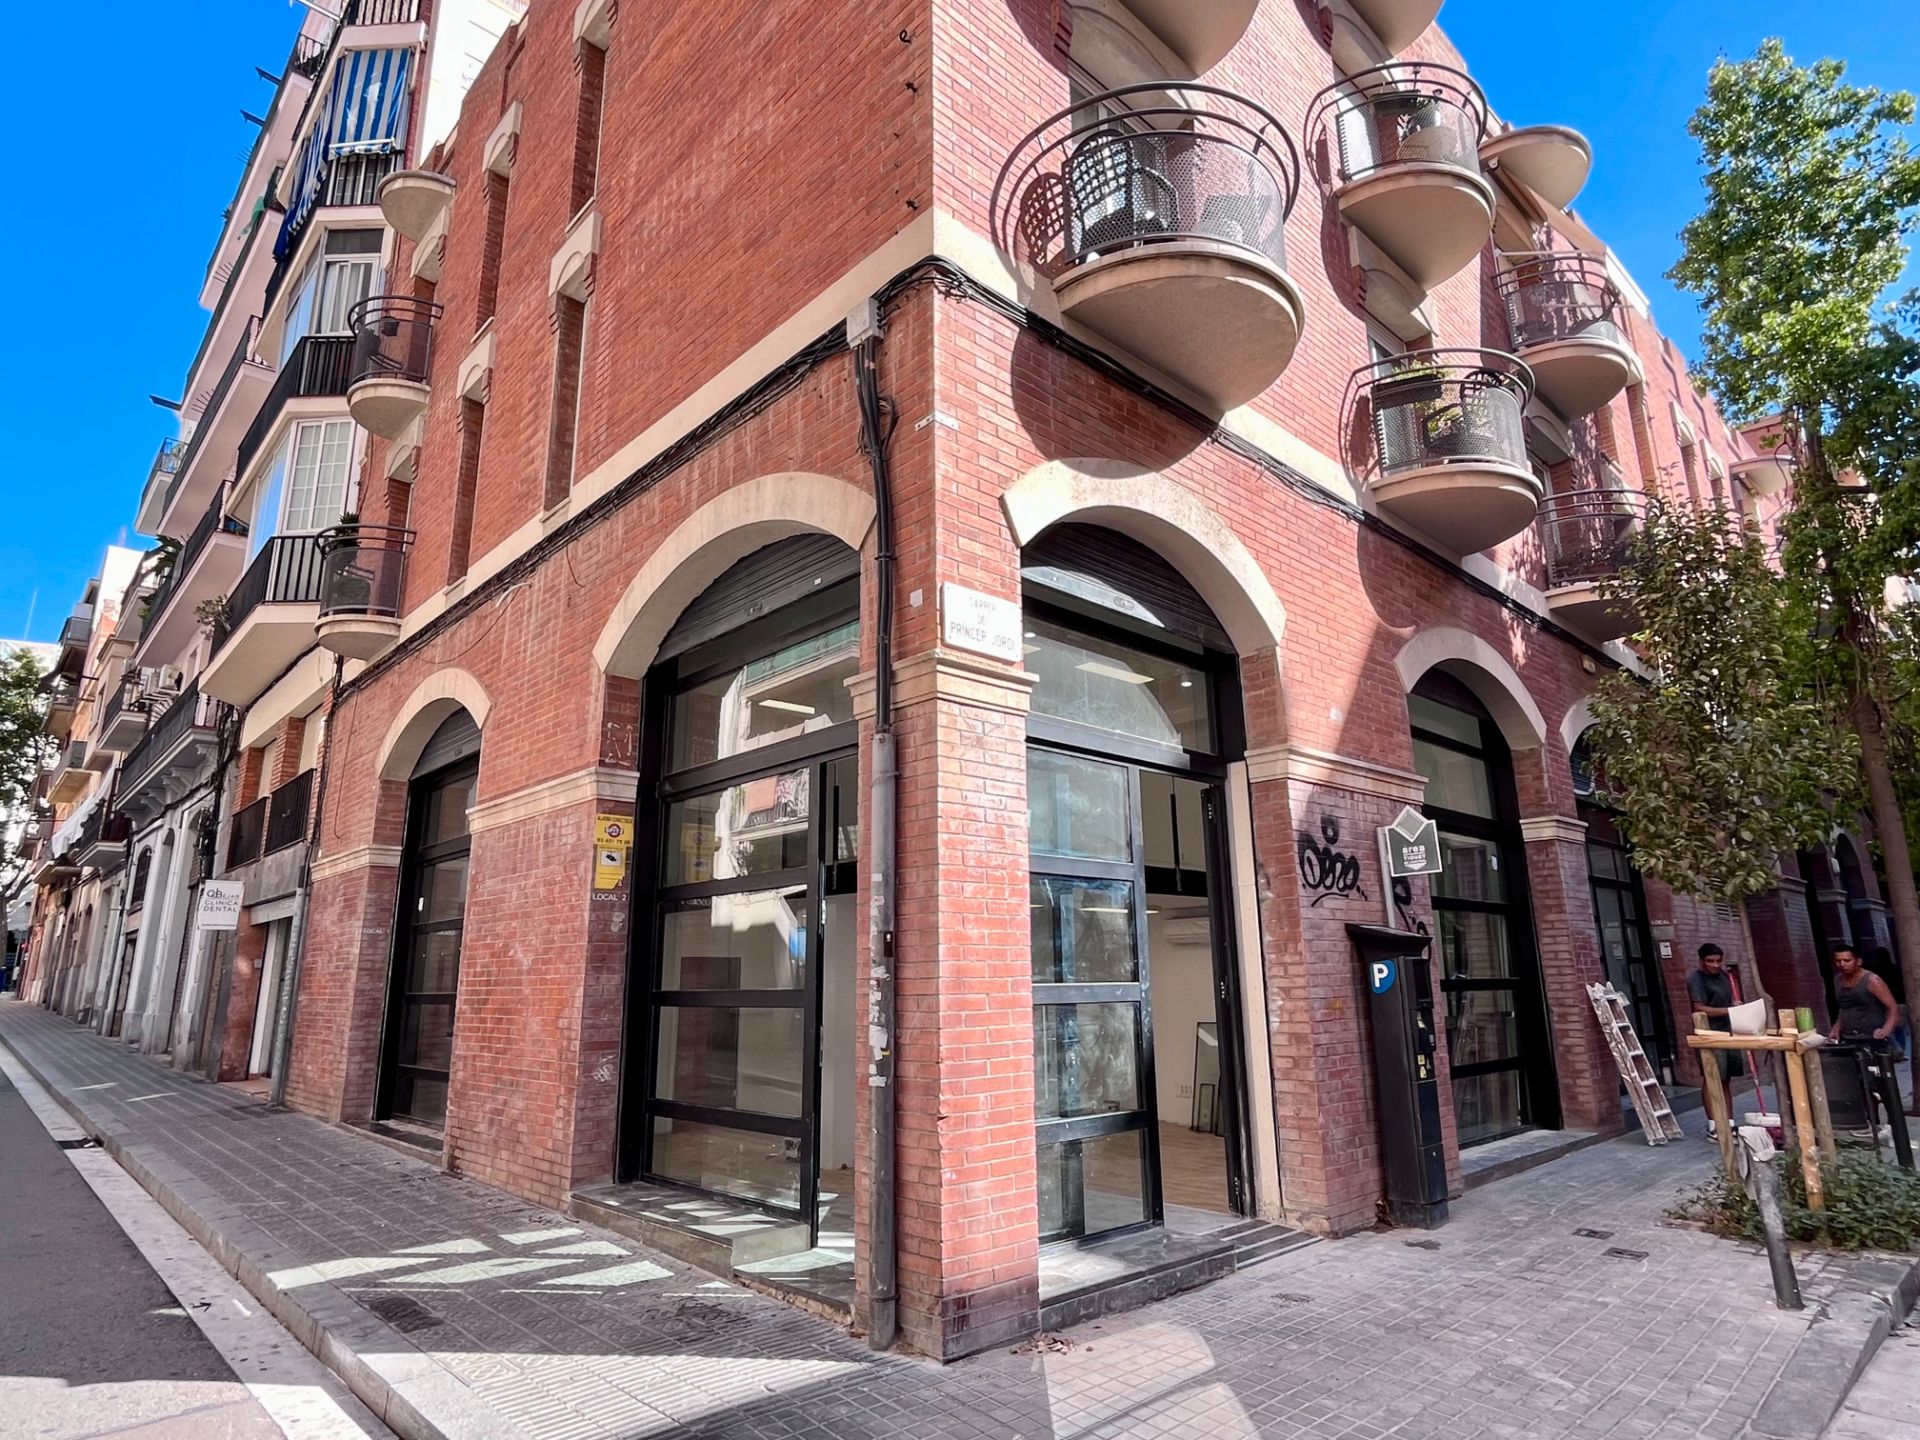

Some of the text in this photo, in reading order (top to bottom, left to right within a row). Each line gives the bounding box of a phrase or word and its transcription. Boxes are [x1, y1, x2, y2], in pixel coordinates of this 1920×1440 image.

[969, 596, 996, 612] CARRER
[992, 634, 1016, 650] JORDI
[592, 892, 618, 901] LOCAL
[1372, 963, 1389, 988] P
